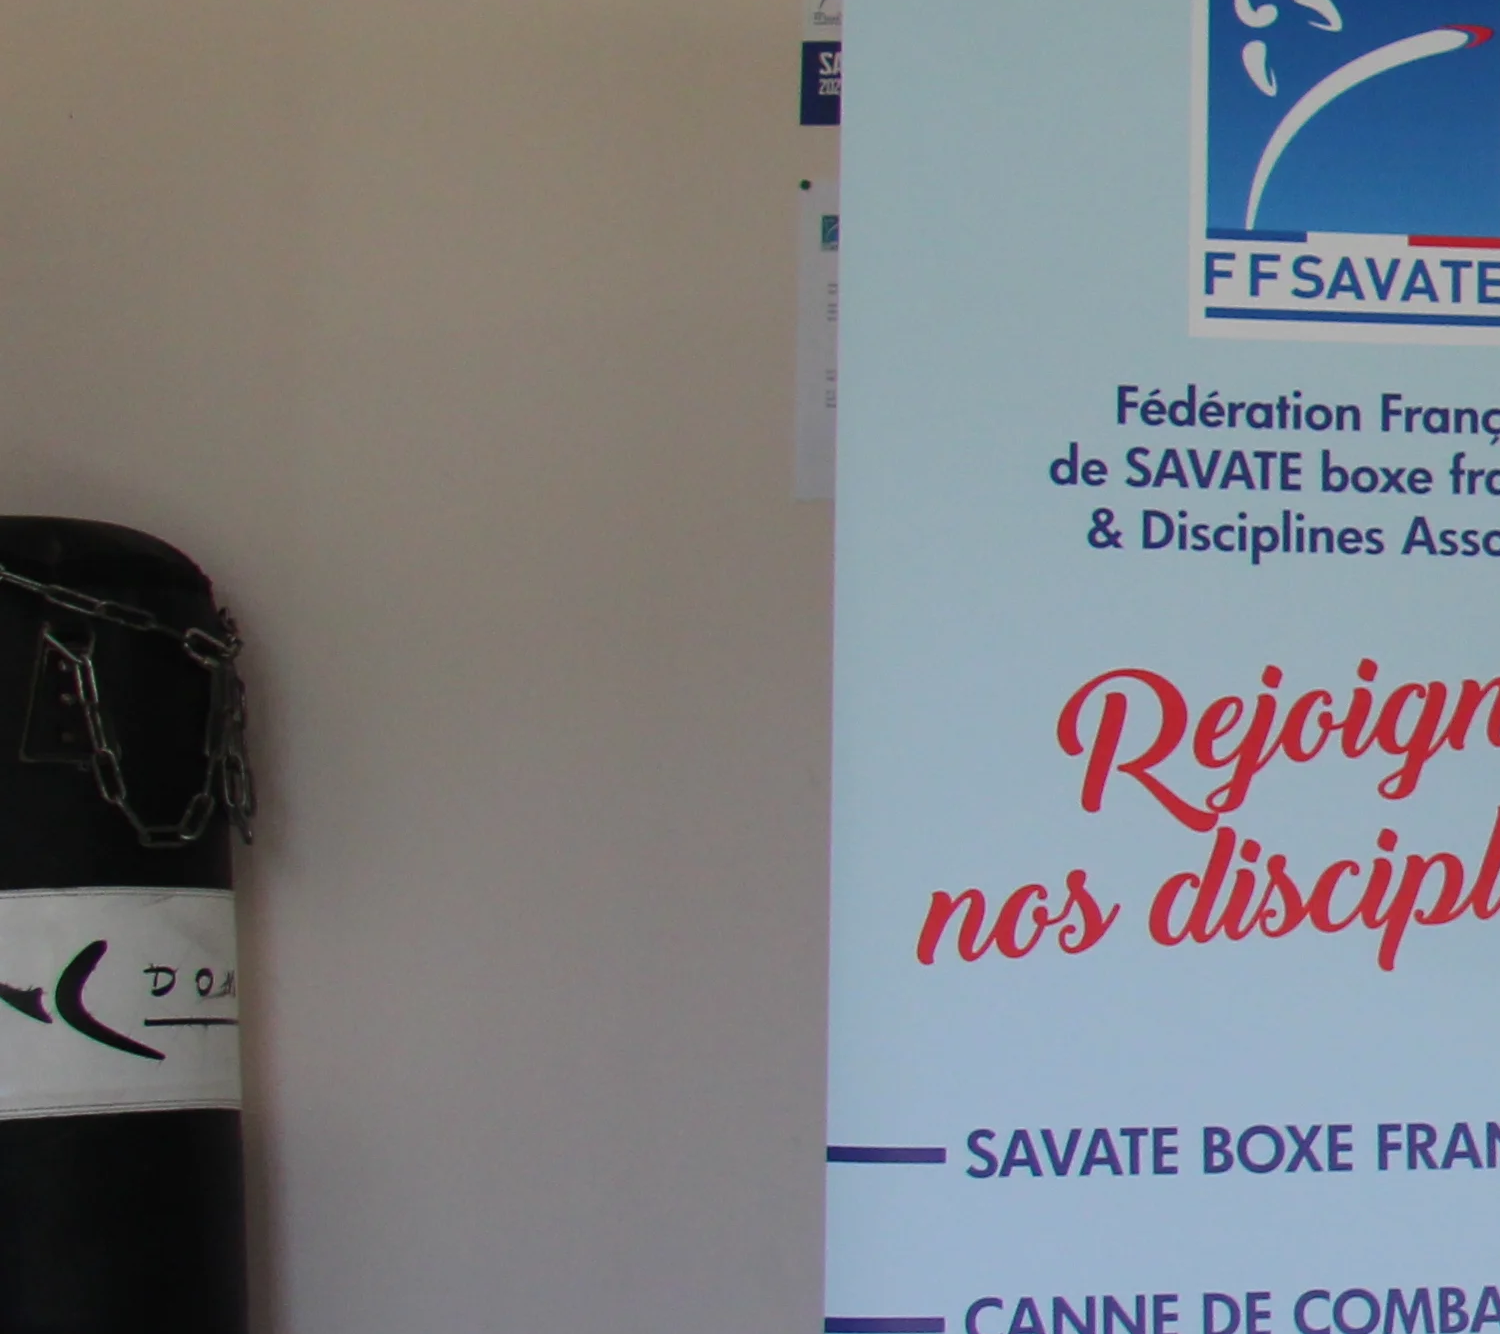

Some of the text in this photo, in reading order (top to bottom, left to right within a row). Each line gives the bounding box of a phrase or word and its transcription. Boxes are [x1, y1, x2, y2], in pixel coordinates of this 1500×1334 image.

[1117, 384, 1360, 431] Fédération
[1050, 442, 1107, 486] de
[1126, 447, 1301, 491] SAVATE
[1322, 450, 1432, 494] boxe
[1087, 508, 1122, 548] &
[1143, 510, 1384, 565] Disciplines
[917, 870, 1120, 965] nos
[966, 1128, 1178, 1178] SAVATE
[1203, 1125, 1352, 1174] BOXE
